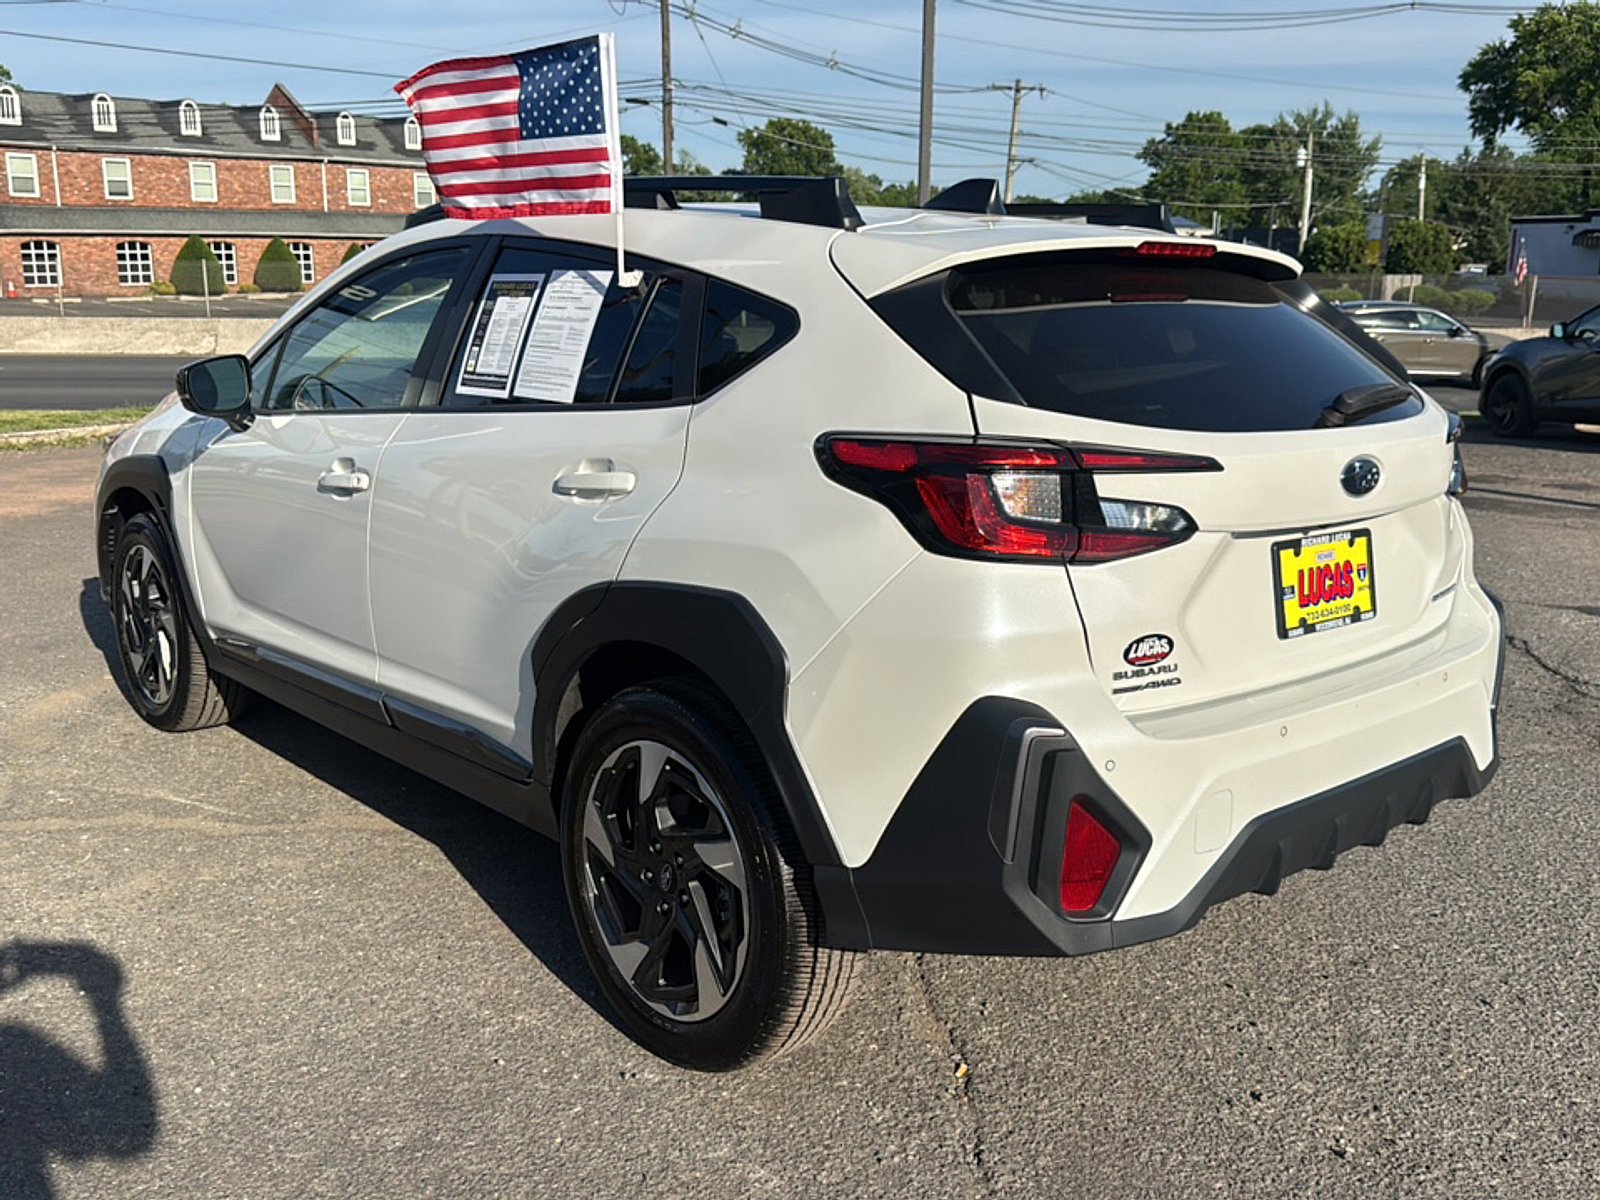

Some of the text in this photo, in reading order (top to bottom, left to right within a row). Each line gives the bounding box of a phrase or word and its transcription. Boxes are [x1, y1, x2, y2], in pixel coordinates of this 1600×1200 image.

[1298, 560, 1354, 608] LUCAS
[1128, 637, 1170, 659] LUCAS
[1112, 663, 1178, 681] SUBARU
